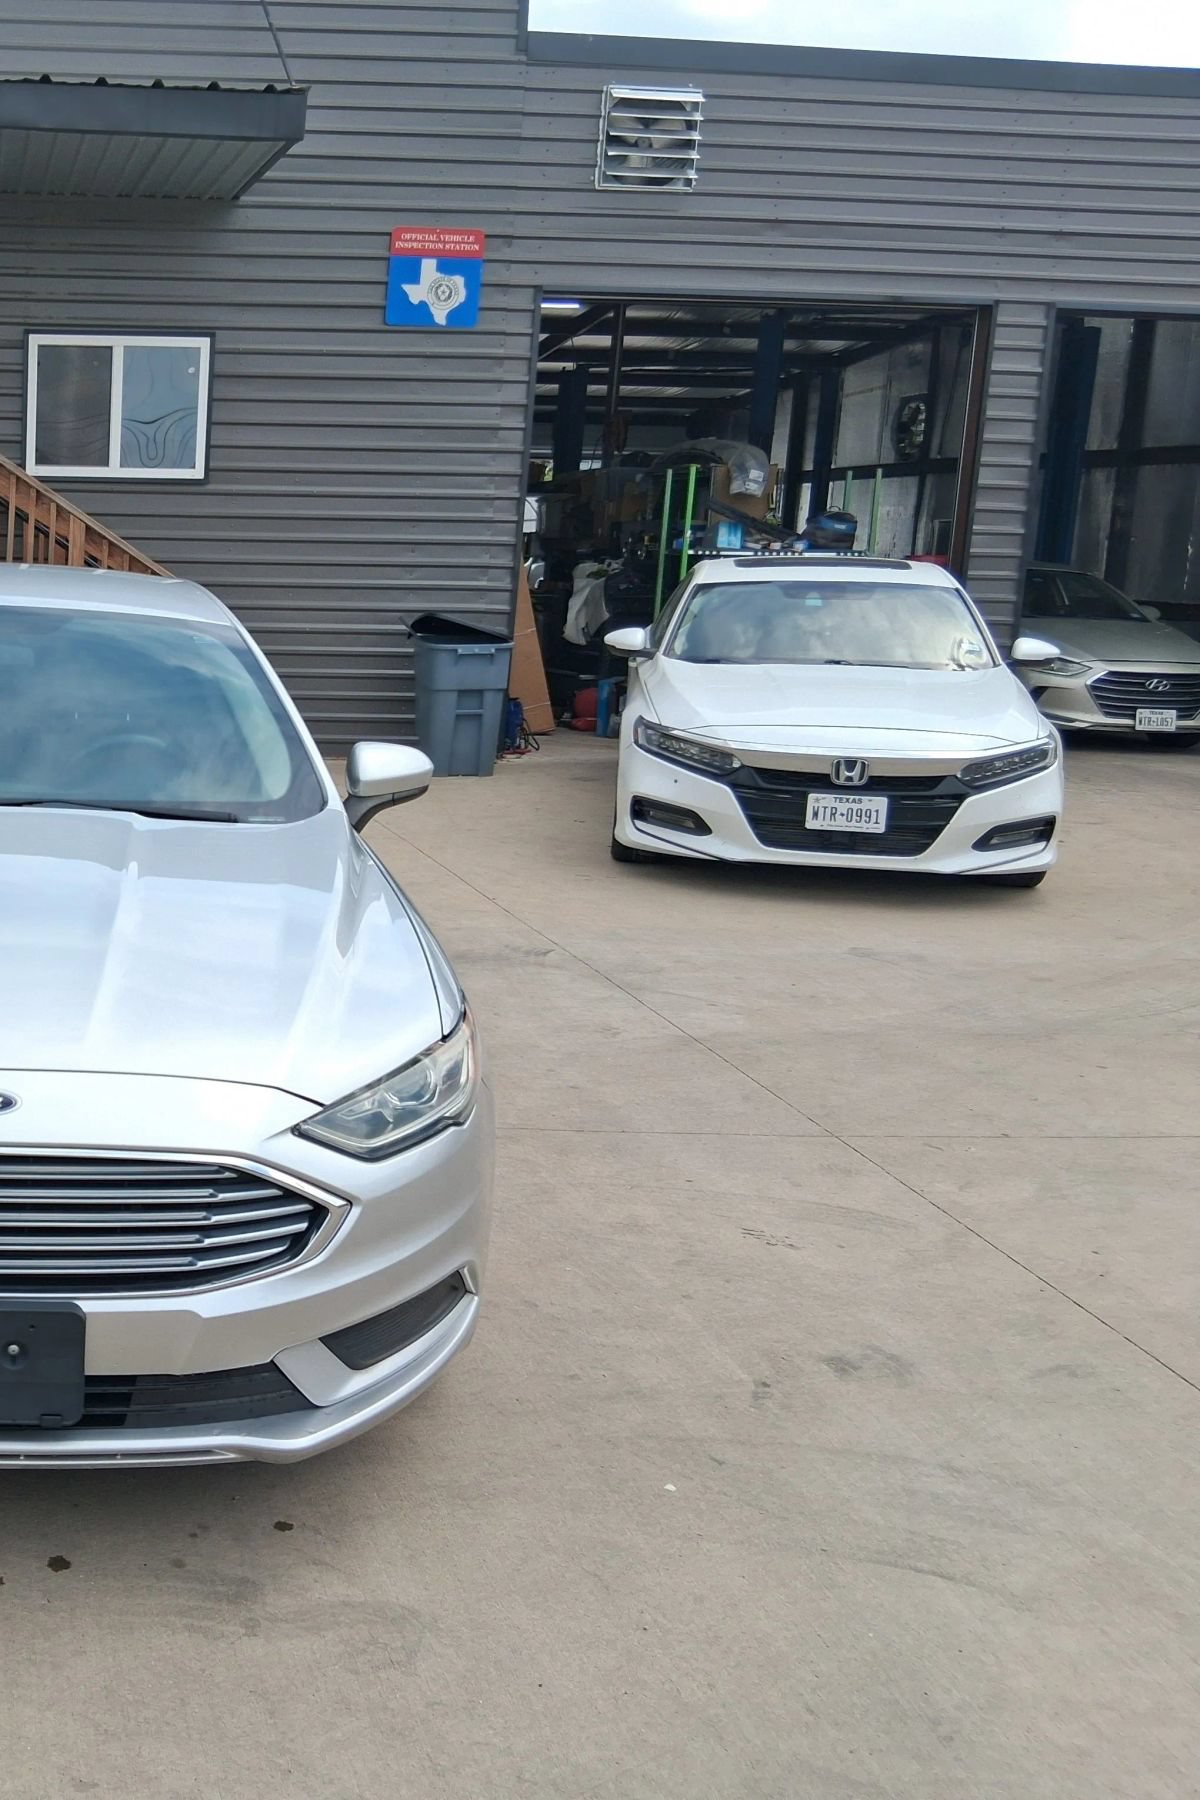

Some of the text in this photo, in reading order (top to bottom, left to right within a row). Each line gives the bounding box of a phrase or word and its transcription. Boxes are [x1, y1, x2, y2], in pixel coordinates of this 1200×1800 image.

[401, 233, 475, 243] OFFICIAL VEHICLE
[395, 241, 480, 251] INSPECTION STATION
[832, 796, 863, 805] TEXAS
